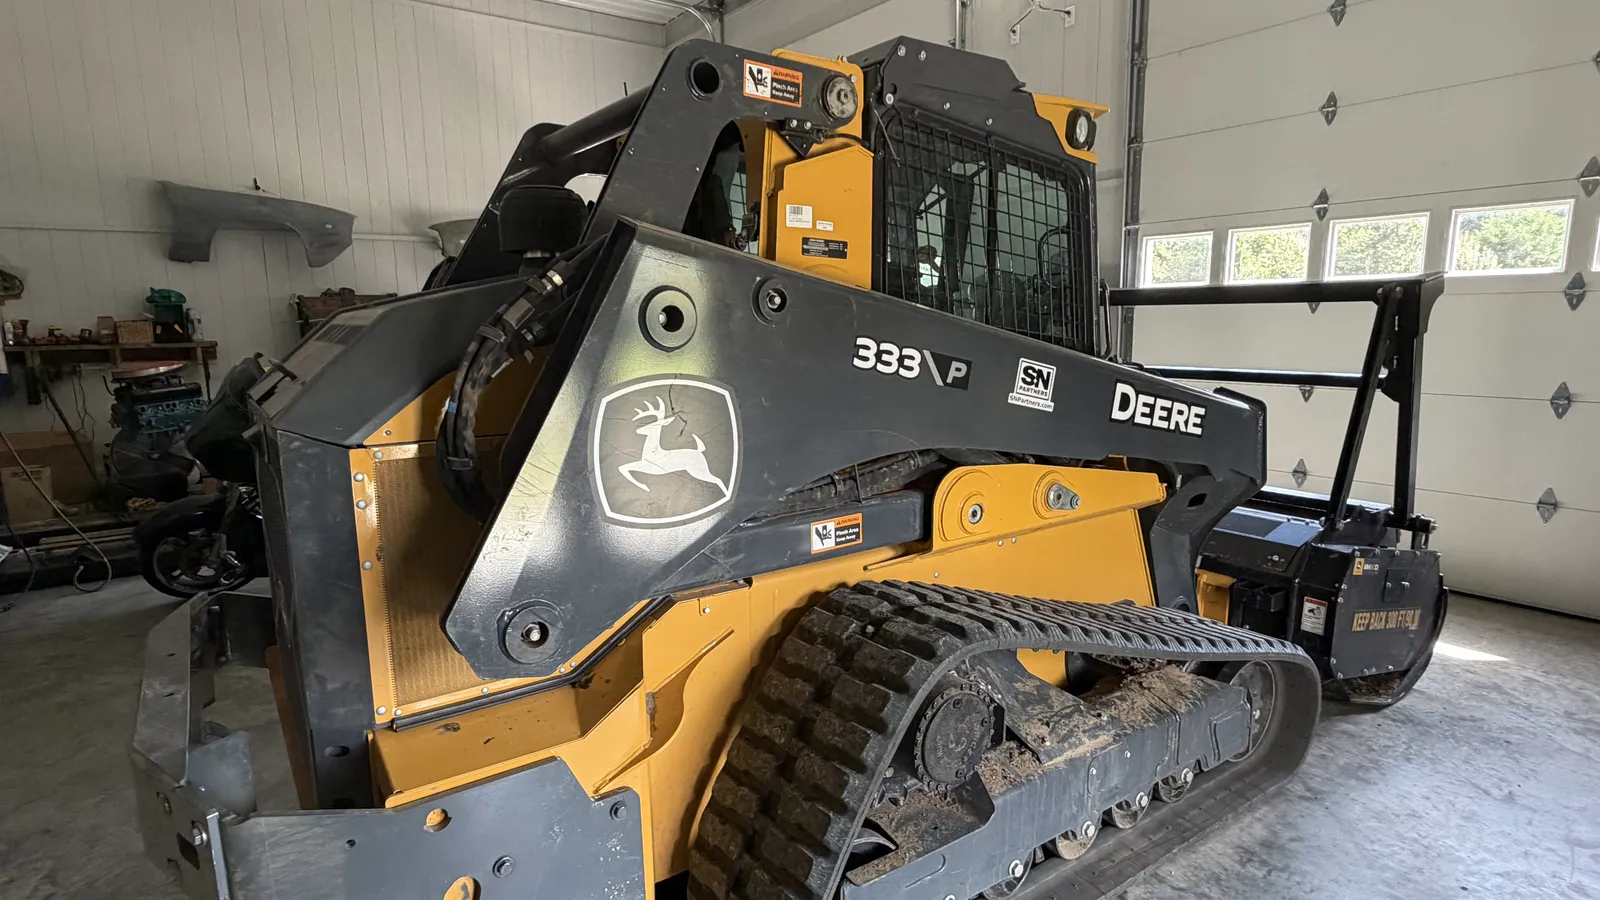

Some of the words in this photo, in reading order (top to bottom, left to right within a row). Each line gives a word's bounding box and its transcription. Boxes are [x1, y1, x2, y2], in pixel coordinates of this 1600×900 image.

[772, 81, 787, 90] Pinch
[772, 89, 783, 97] Keep
[783, 92, 795, 100] Away
[853, 337, 922, 379] 333
[1021, 365, 1051, 391] SN
[1019, 385, 1048, 397] PARTNERS
[1009, 394, 1053, 409] SNPartners.com
[1111, 382, 1206, 435] DEERE
[1352, 612, 1371, 632] KEEP
[1369, 611, 1387, 630] BACK
[1386, 610, 1399, 629] 300
